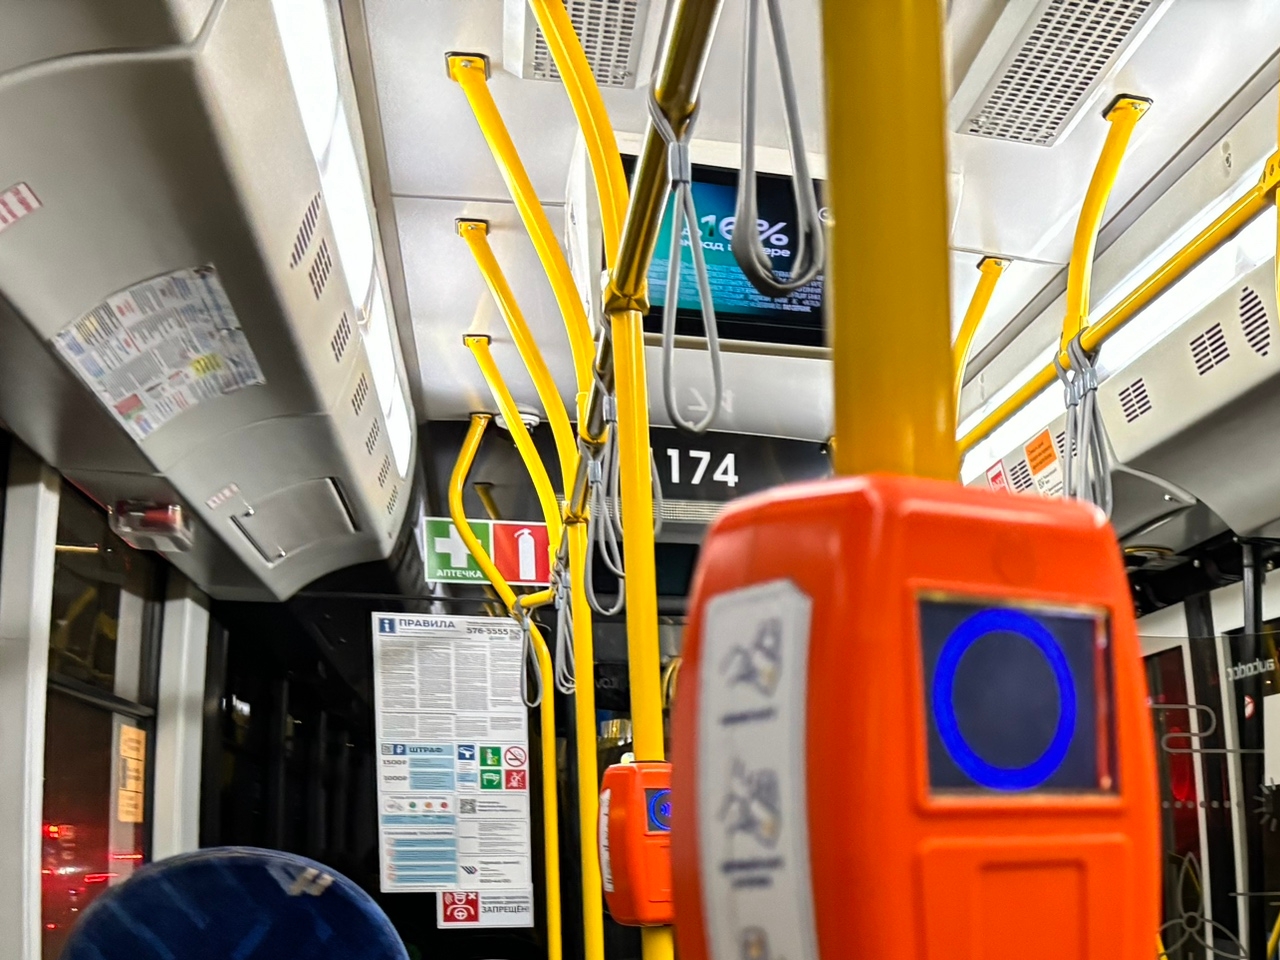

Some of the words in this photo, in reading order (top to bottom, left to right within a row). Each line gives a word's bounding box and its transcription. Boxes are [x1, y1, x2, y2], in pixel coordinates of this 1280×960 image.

[667, 448, 739, 488] 174
[436, 568, 483, 578] АПТЕЧКА
[399, 618, 456, 629] ПРАВИЛА
[466, 627, 509, 636] 576-5555
